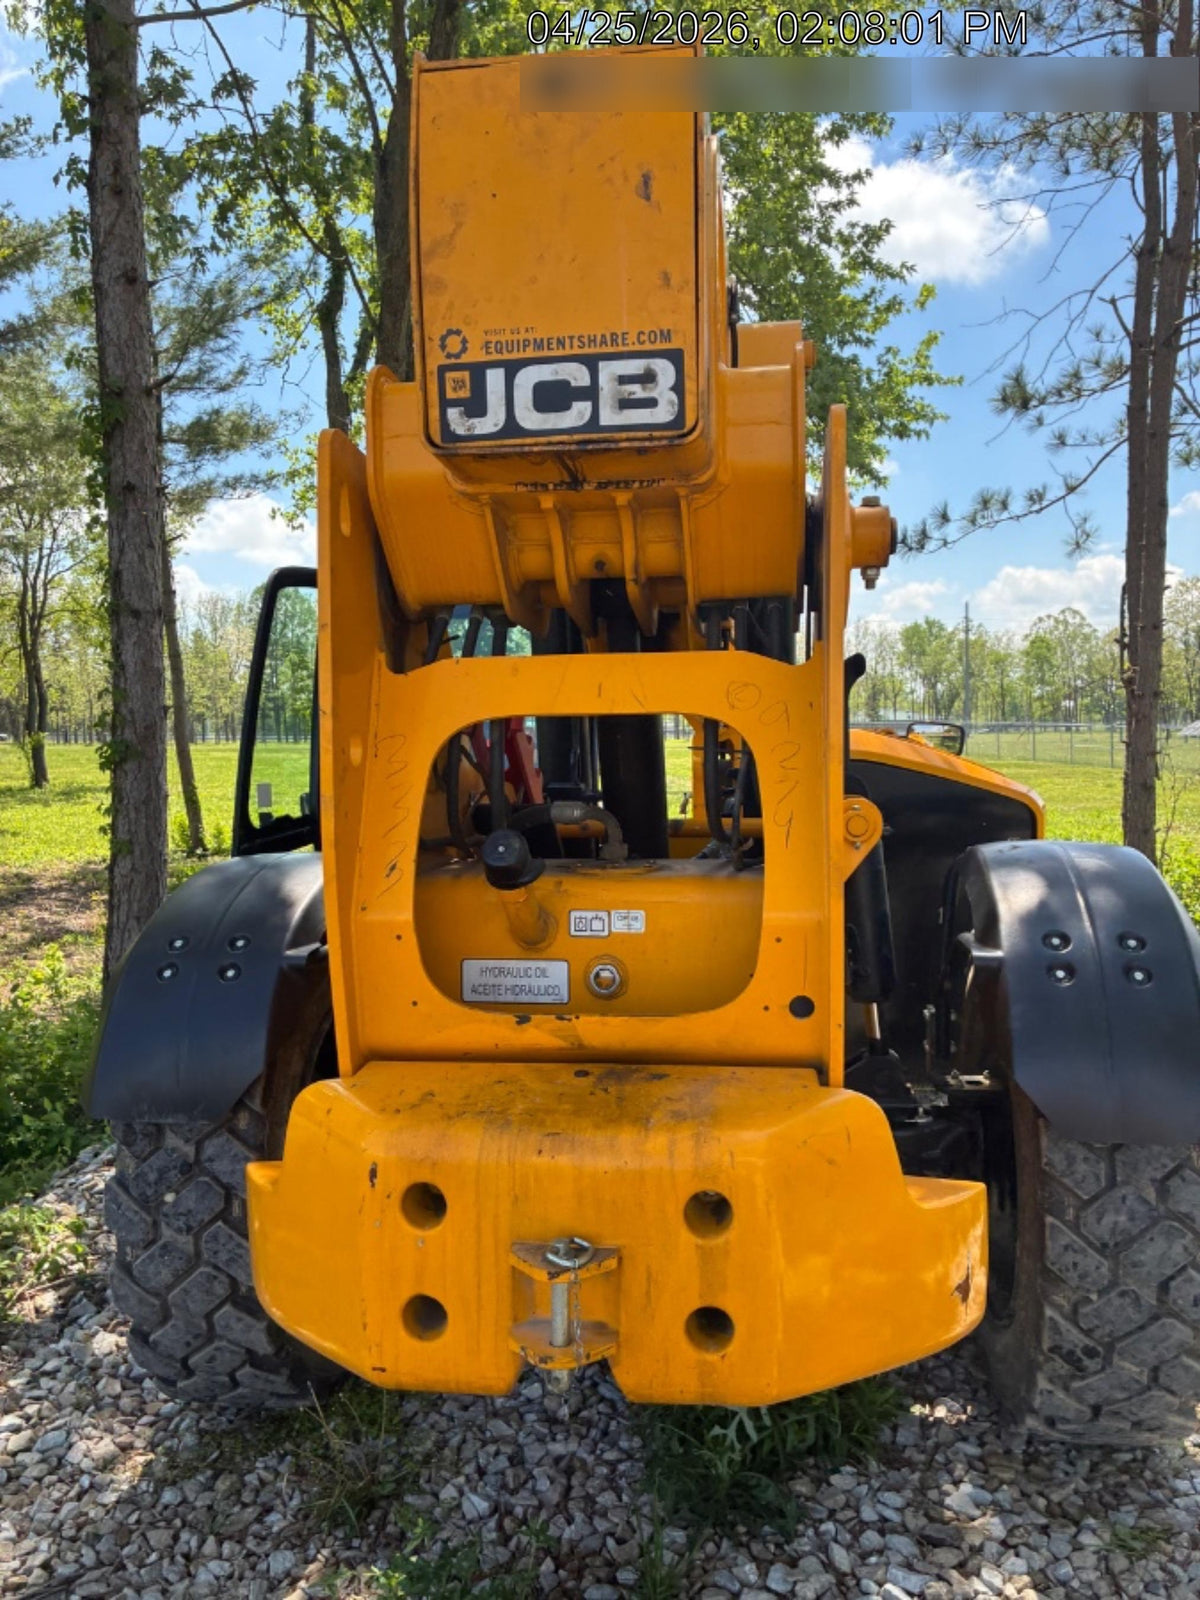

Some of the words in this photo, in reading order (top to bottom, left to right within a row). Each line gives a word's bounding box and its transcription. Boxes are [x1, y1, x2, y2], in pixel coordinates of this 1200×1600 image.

[484, 328, 506, 336] VISIT
[484, 329, 672, 355] EQUIPMENTSHARE.COM
[446, 358, 679, 436] JCB
[481, 966, 532, 979] HYDRAULIC
[534, 967, 550, 979] OIL
[470, 983, 503, 996] ACEITE
